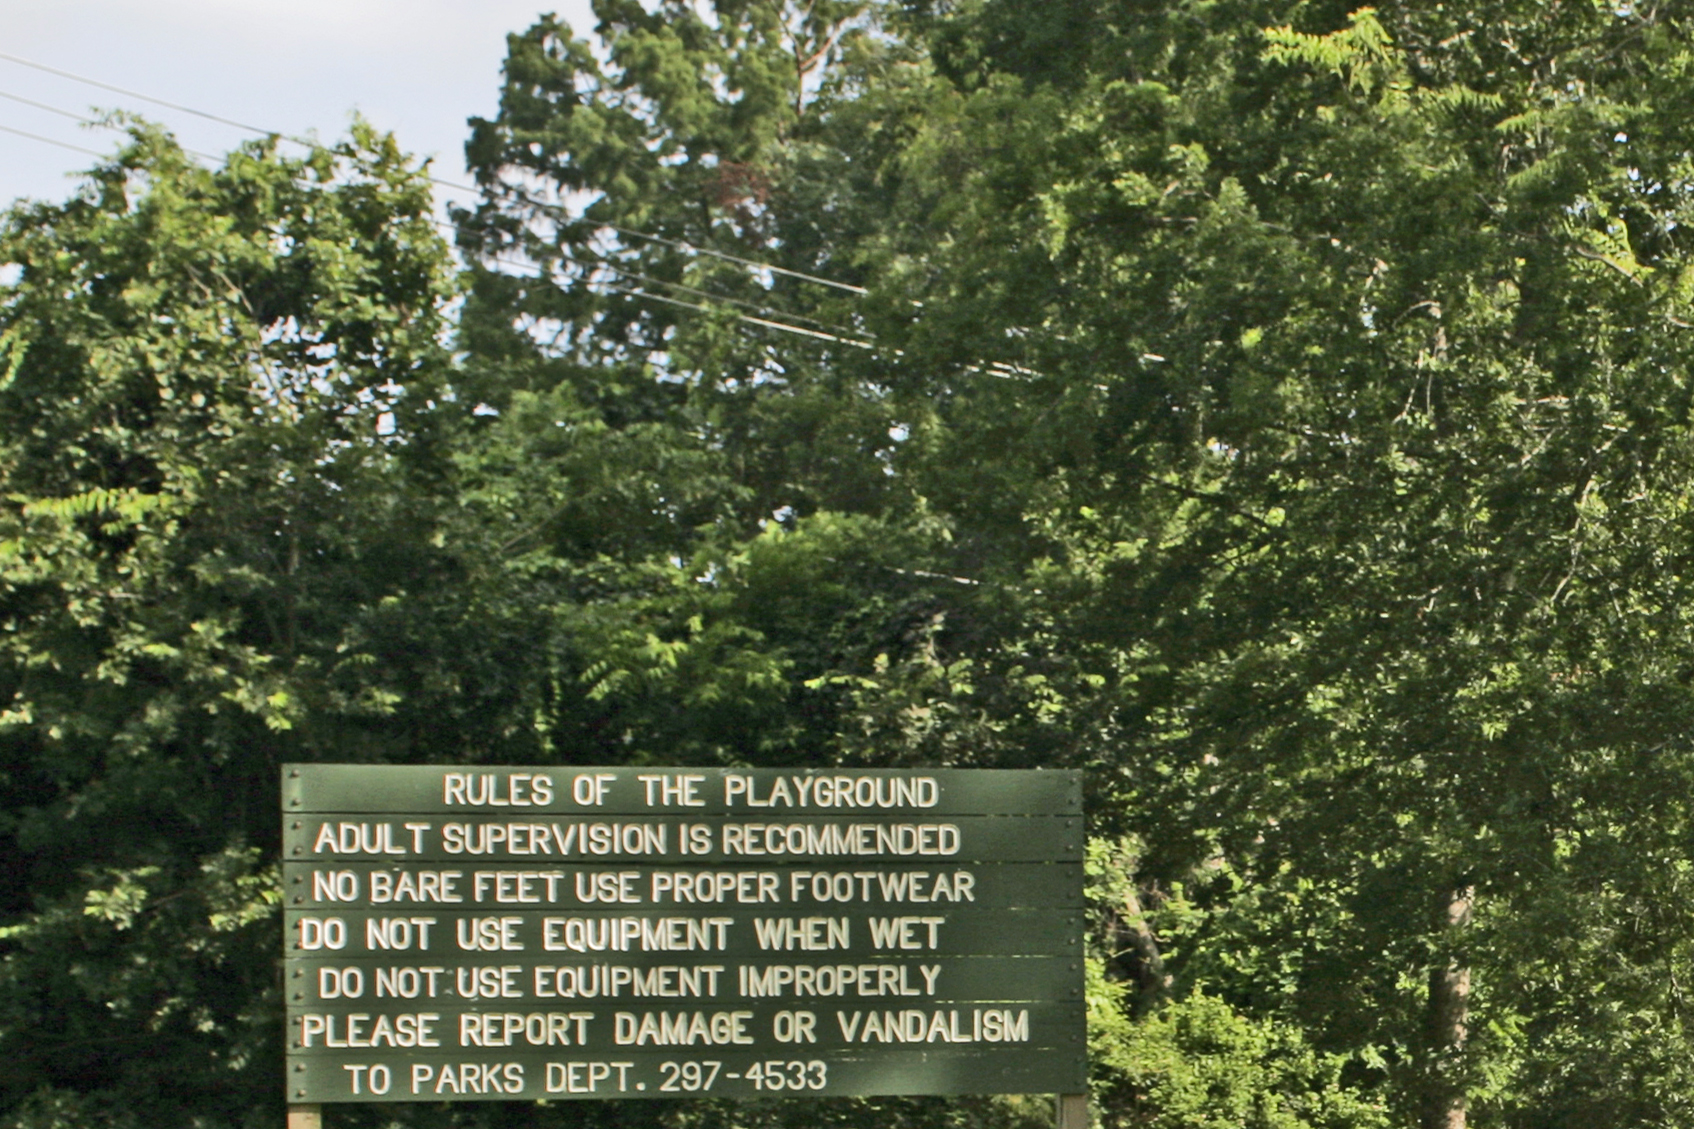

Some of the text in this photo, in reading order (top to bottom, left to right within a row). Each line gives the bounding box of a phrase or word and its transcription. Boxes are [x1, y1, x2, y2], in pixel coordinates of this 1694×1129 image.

[444, 772, 939, 808] RULES OF THE PLAYGROUND
[314, 822, 961, 856] ADULT SUPERVISION IS RECOMMENDED
[313, 870, 975, 904] NO BARE FEET USE PROPER FOOTWEAR
[301, 916, 945, 953] DO NOT USE EQUIPMENT WHEN WET
[320, 965, 941, 999] DO NOT USE EQUIPMENT IMPROPERLY
[303, 1009, 1029, 1048] PLEASE REPORT DAMAGE OR VANDALISM
[343, 1060, 827, 1095] TO PARKS DEPT. 297-4533
